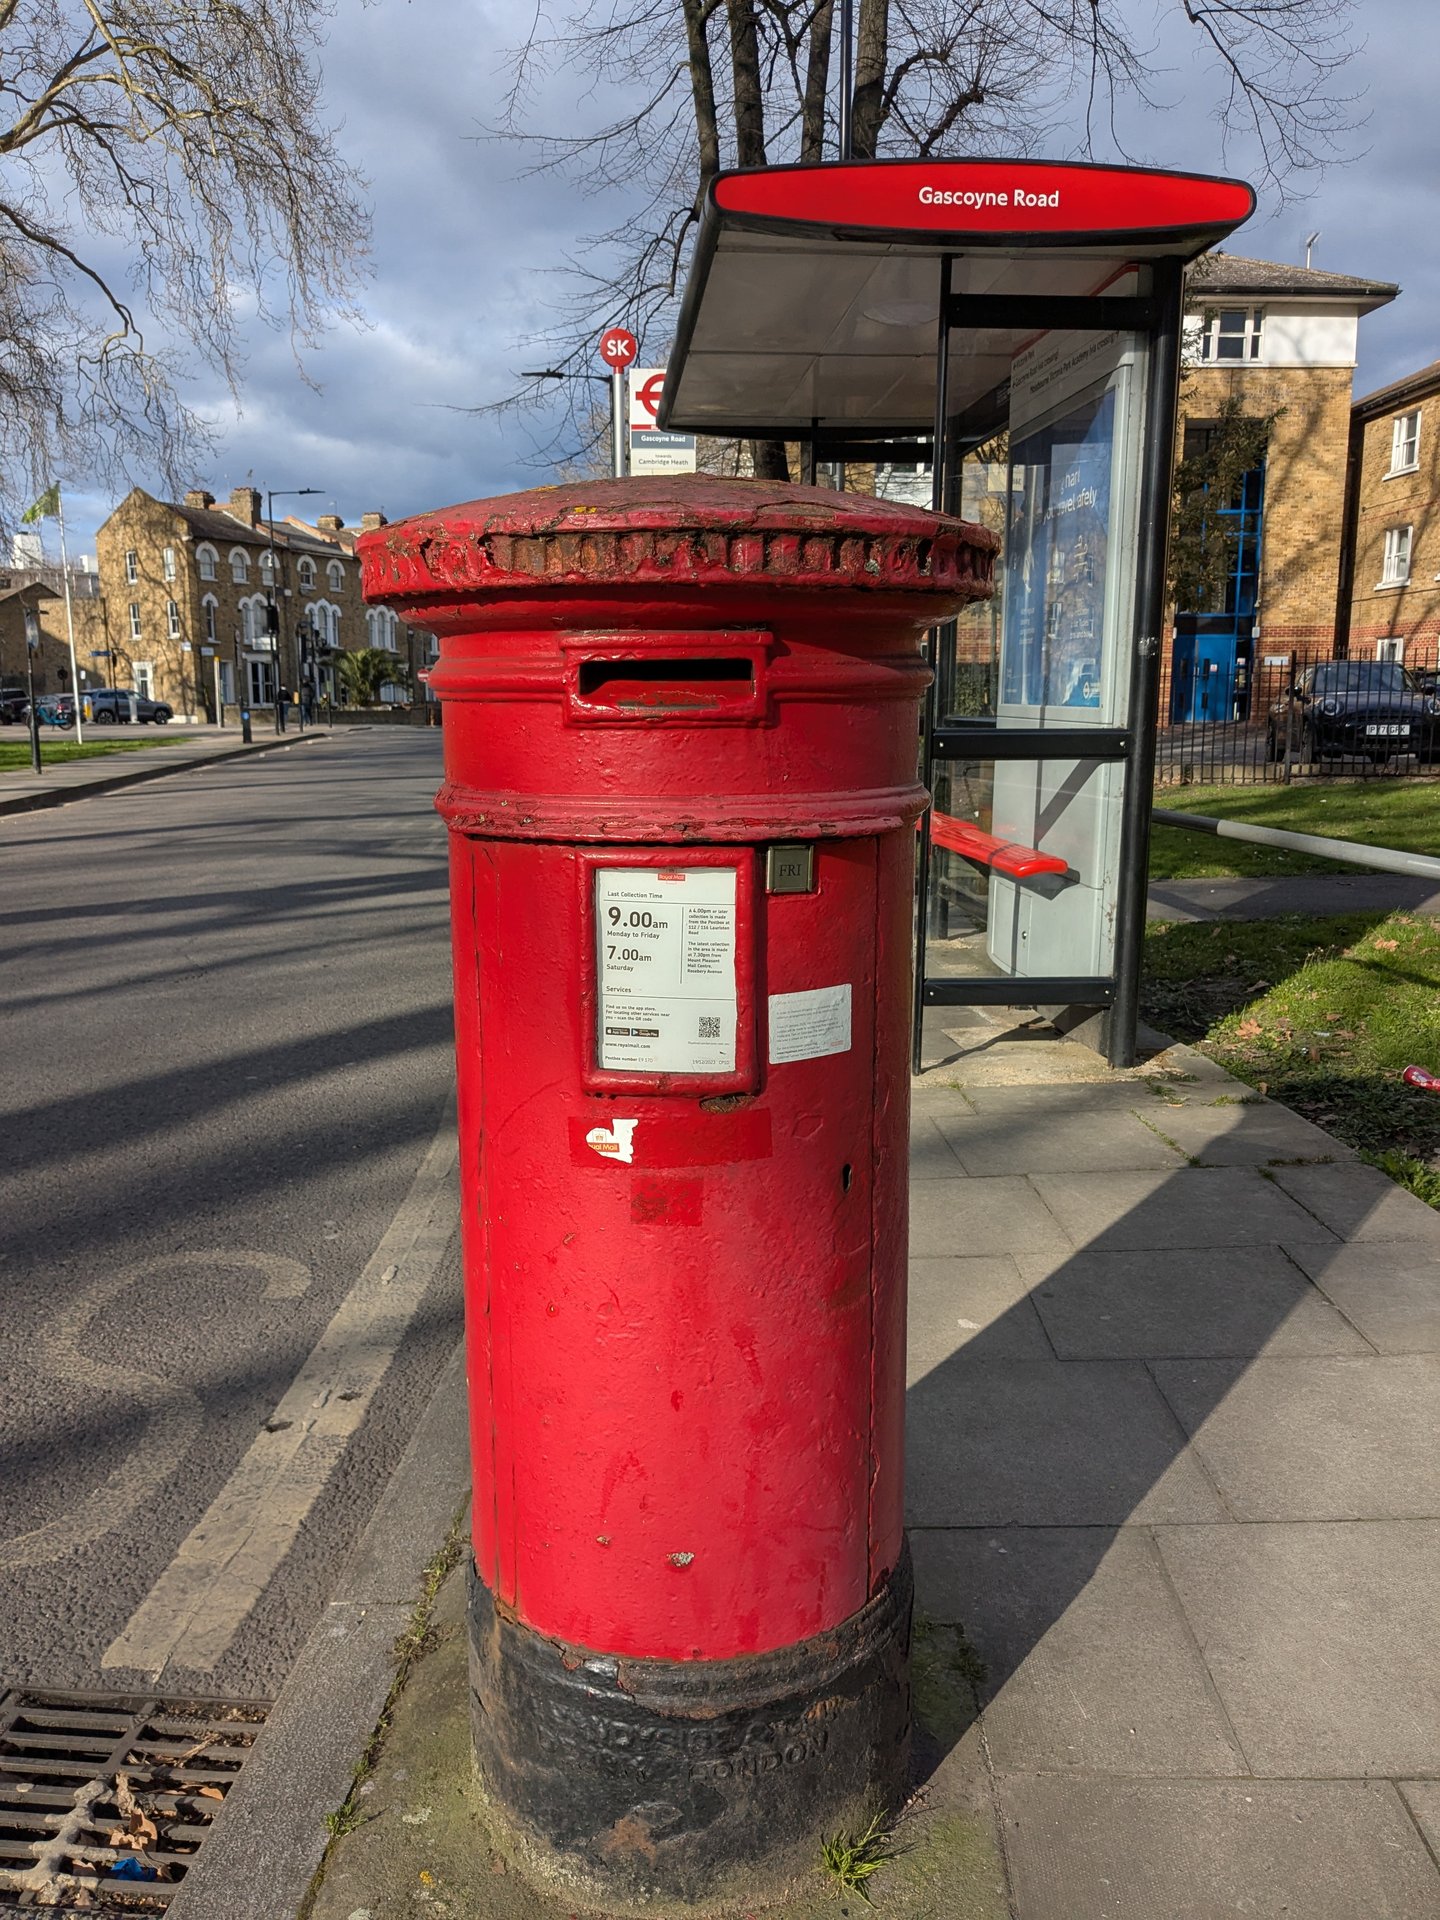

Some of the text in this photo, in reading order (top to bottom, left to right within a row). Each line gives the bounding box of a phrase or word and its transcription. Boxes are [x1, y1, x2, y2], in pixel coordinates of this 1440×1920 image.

[918, 186, 1060, 210] Gascoyne Road
[606, 339, 630, 357] SK
[641, 434, 686, 443] Gascoyne Road
[638, 458, 670, 466] Cambridge
[779, 863, 802, 877] FRI
[608, 906, 668, 929] 9.00am
[607, 930, 632, 938] Monday
[640, 931, 660, 939] Friday
[607, 945, 652, 962] 7.00am
[606, 963, 634, 972] Saturday
[606, 985, 632, 993] Services
